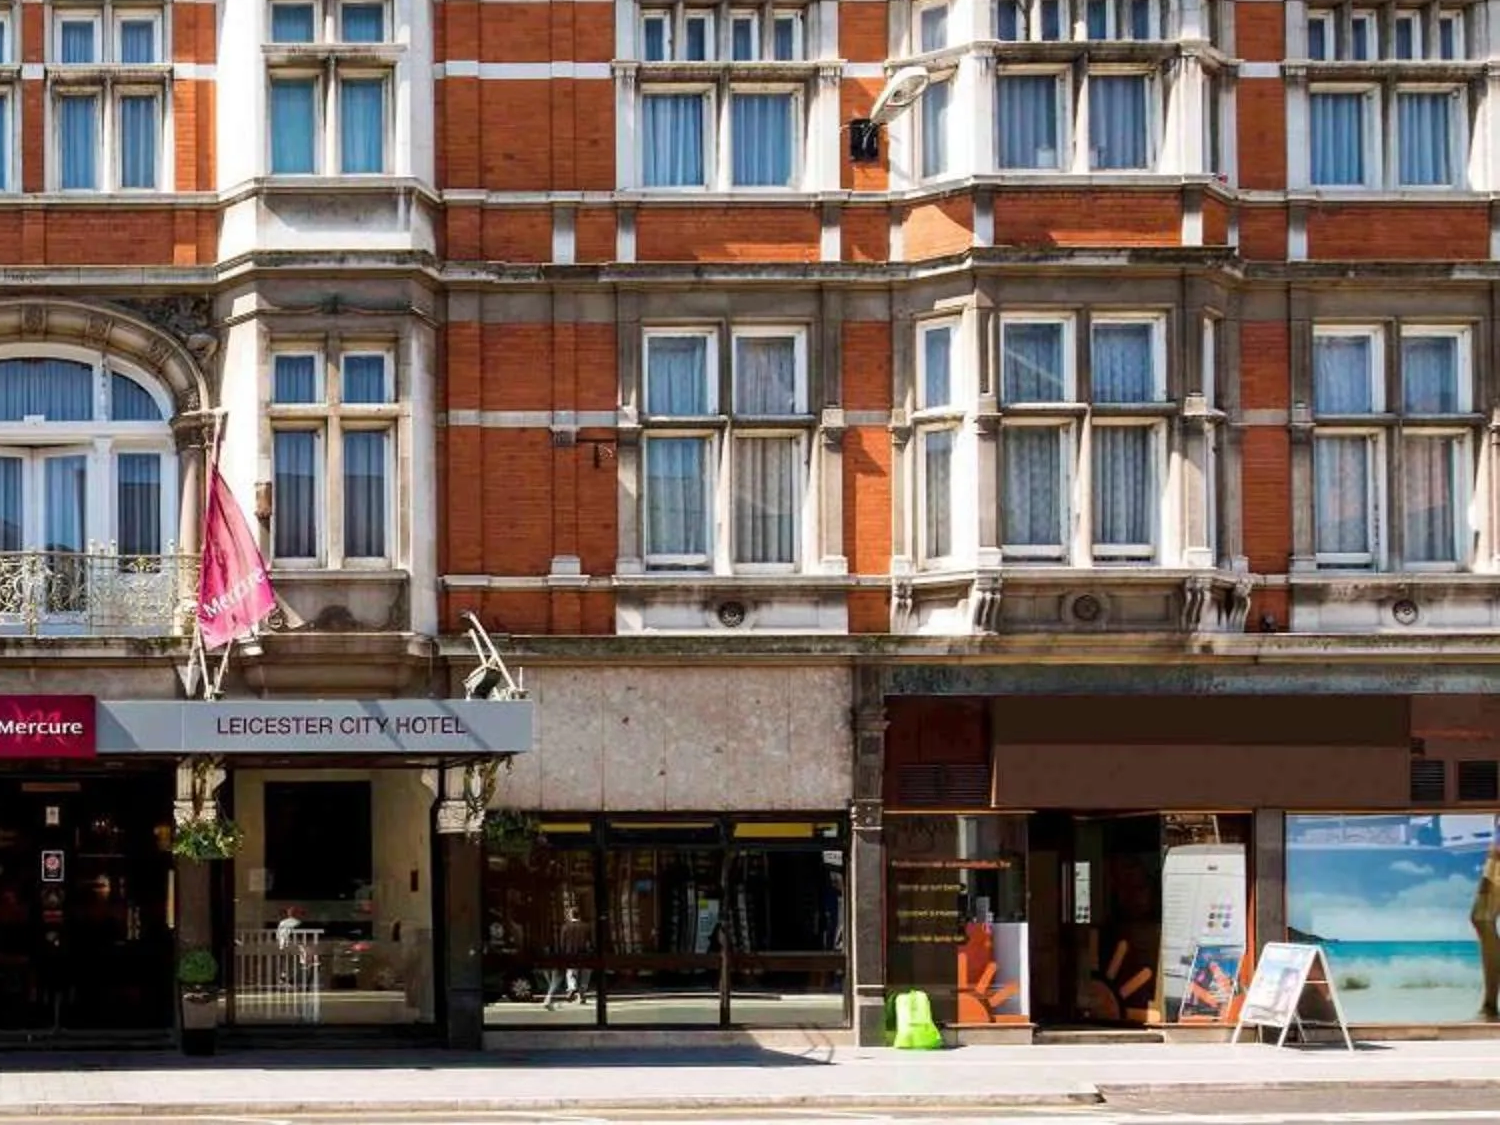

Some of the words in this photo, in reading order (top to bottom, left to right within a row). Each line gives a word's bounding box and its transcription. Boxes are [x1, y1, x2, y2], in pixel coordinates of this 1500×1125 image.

[217, 716, 333, 735] LEICESTER
[339, 716, 389, 734] CITY
[396, 716, 468, 734] HOTEL
